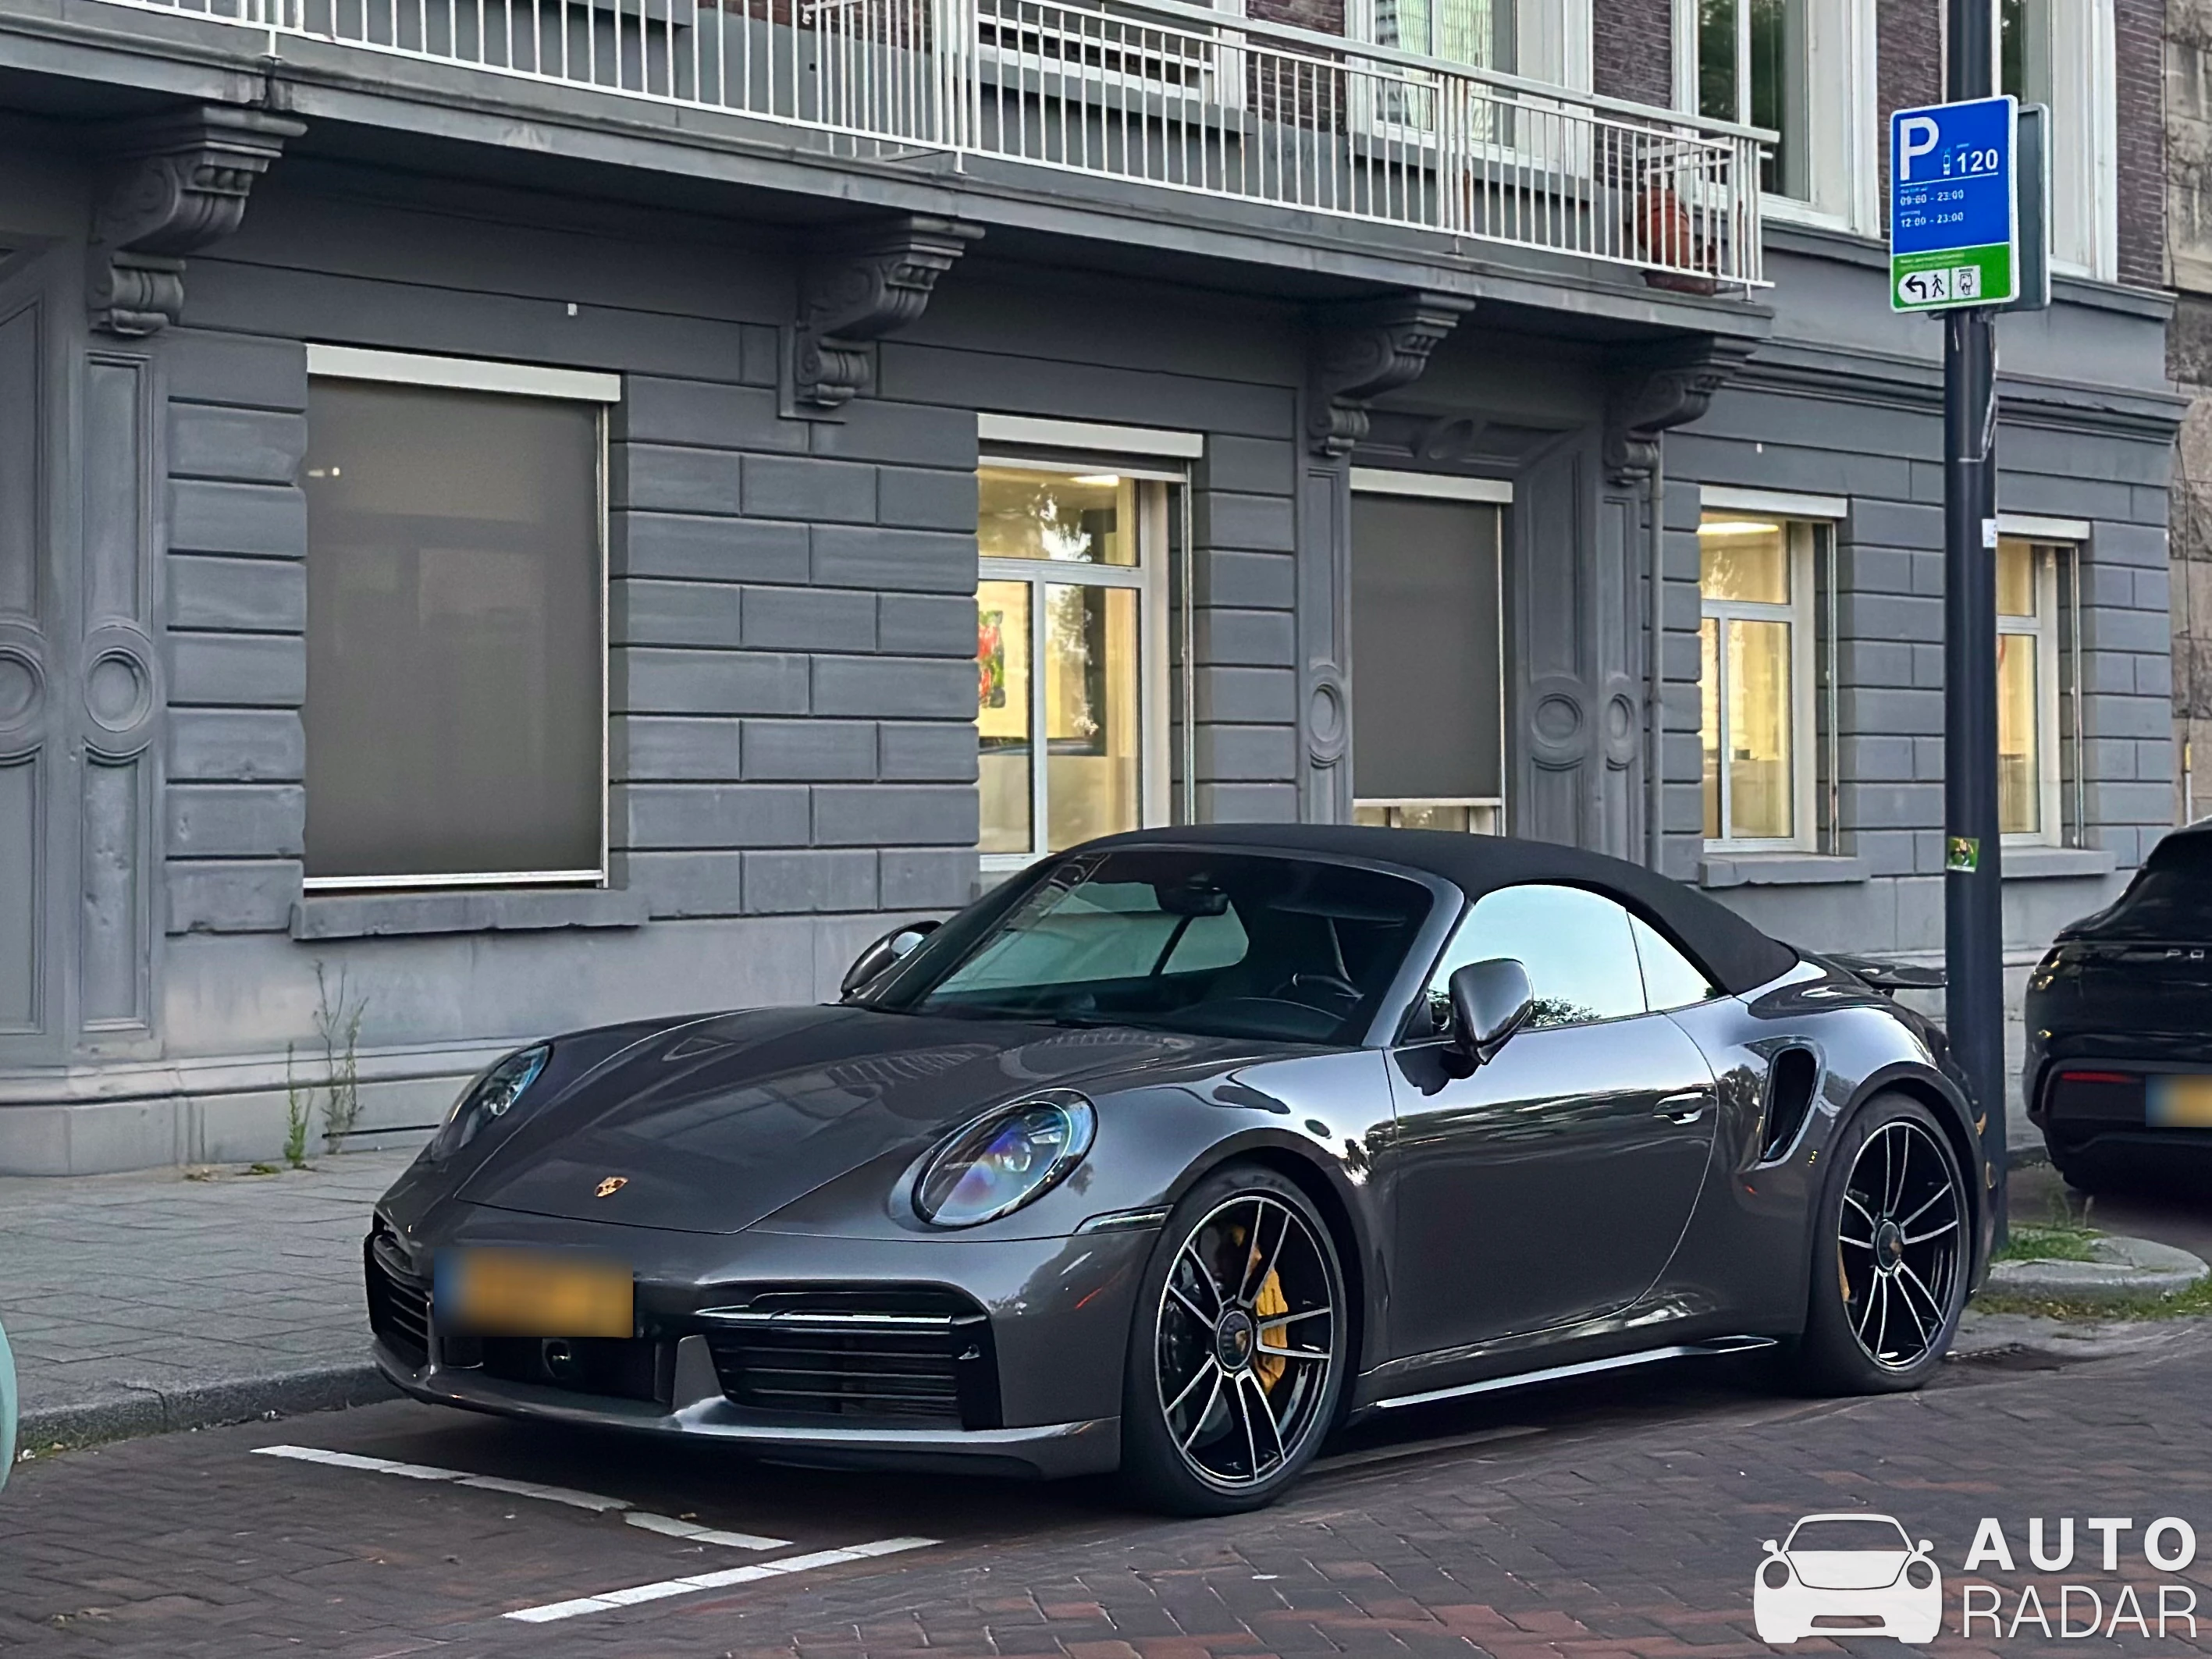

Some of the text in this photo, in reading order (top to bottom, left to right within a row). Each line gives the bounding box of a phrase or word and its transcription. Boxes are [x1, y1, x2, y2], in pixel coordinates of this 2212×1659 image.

[1900, 116, 1940, 181] P
[1957, 148, 1998, 173] 120
[1936, 211, 1964, 224] 23:00
